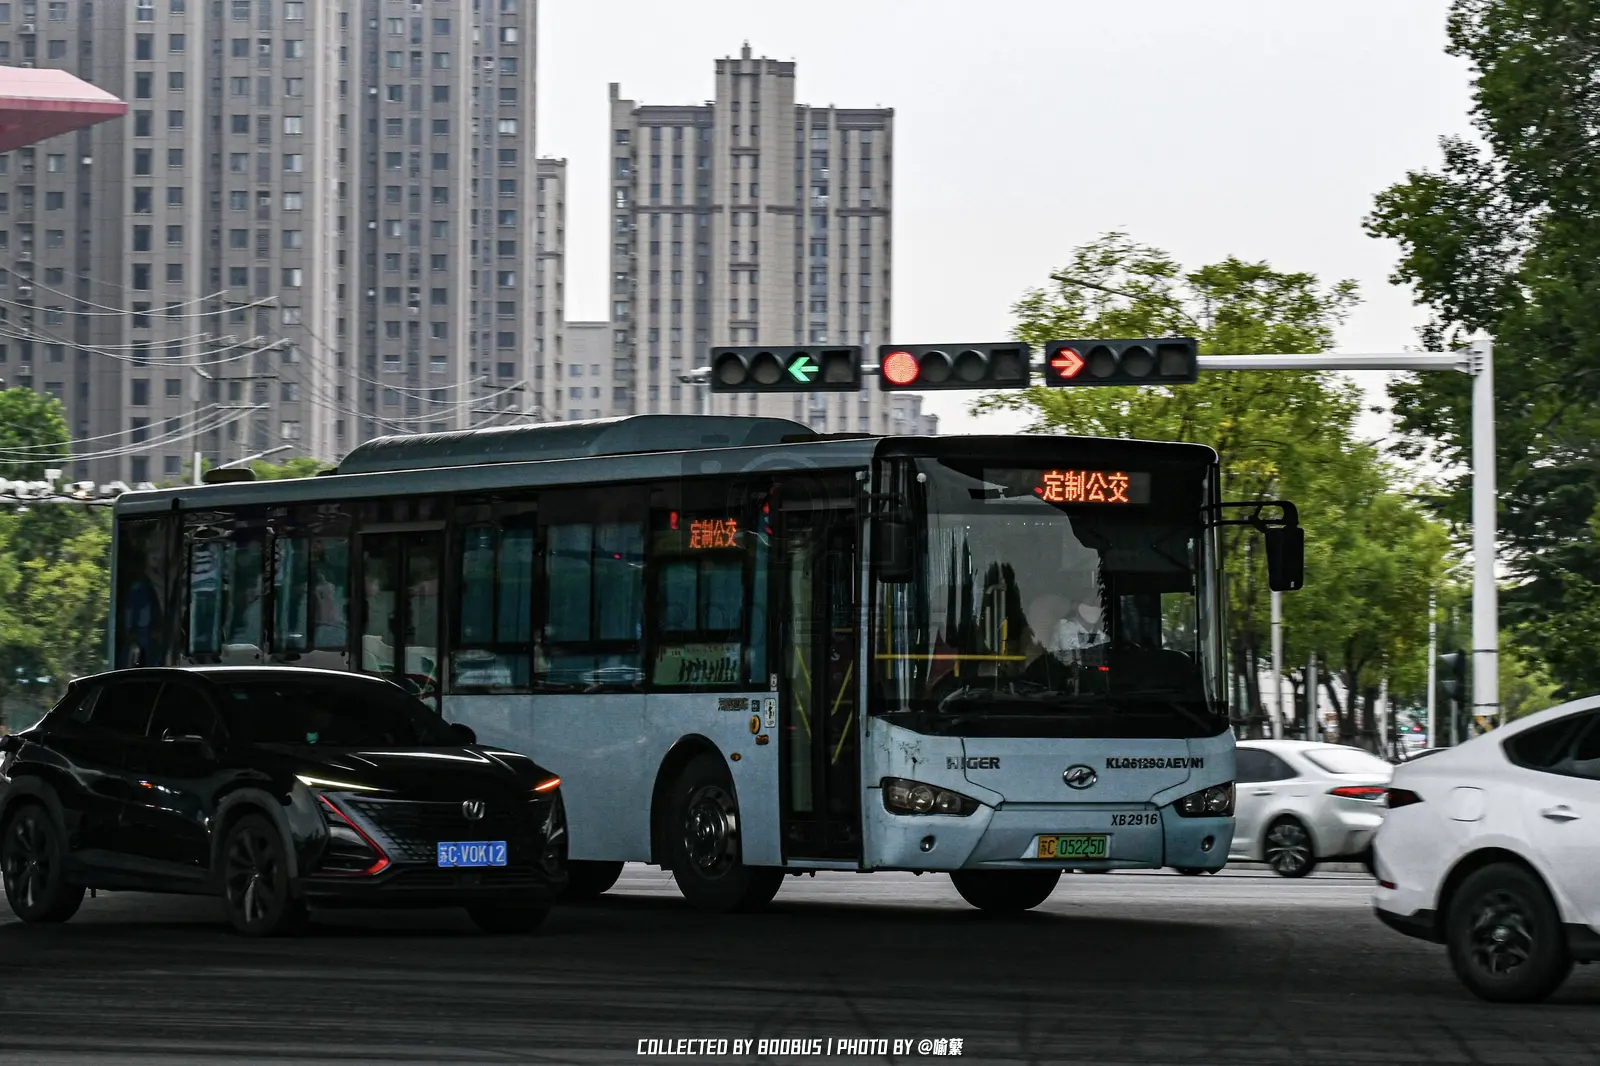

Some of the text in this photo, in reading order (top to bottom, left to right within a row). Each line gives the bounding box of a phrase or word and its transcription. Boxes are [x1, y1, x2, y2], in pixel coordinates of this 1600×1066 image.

[1042, 470, 1128, 502] 定制公交
[689, 518, 737, 548] 定制公交
[947, 756, 1000, 769] HIGER
[1106, 757, 1204, 769] KLQ6129GAEVN1
[1111, 814, 1157, 826] XB2916
